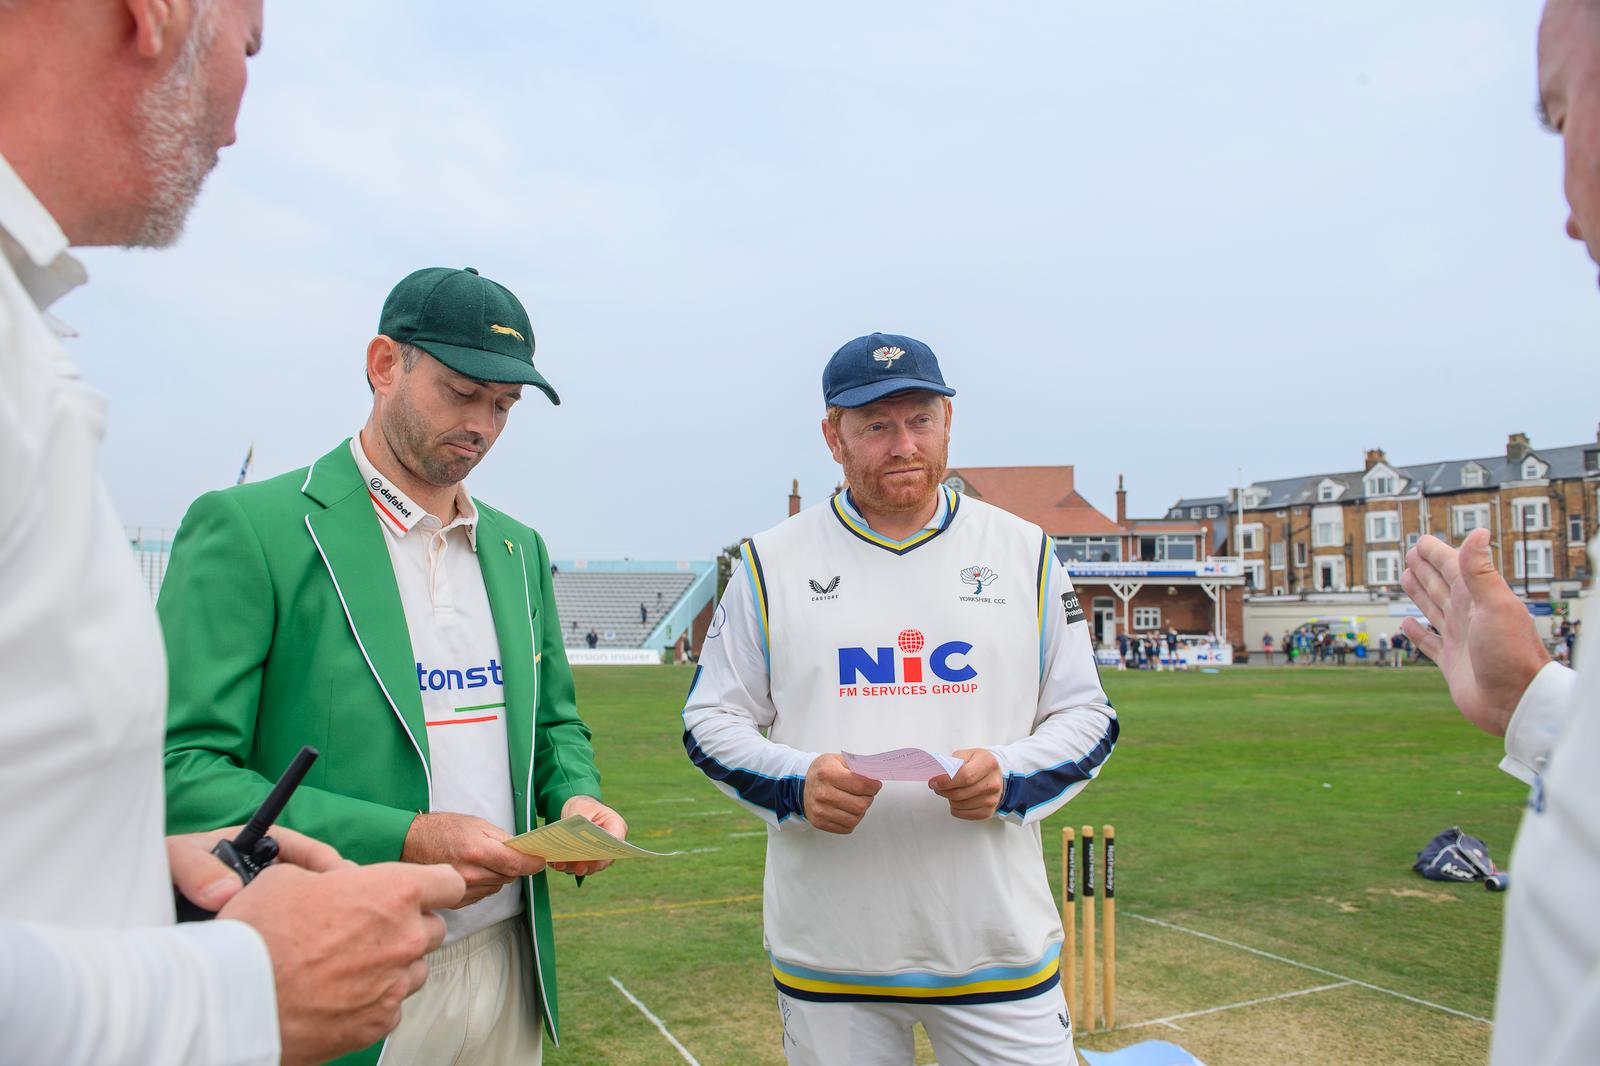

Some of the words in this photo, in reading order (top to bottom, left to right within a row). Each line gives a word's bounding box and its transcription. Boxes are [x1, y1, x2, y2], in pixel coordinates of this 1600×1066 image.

[380, 488, 412, 518] dafabet
[811, 594, 839, 602] CASTORE
[959, 596, 993, 604] YORKSHIRE
[839, 687, 857, 698] FM
[862, 685, 927, 697] SERVICES
[932, 683, 978, 695] GROUP
